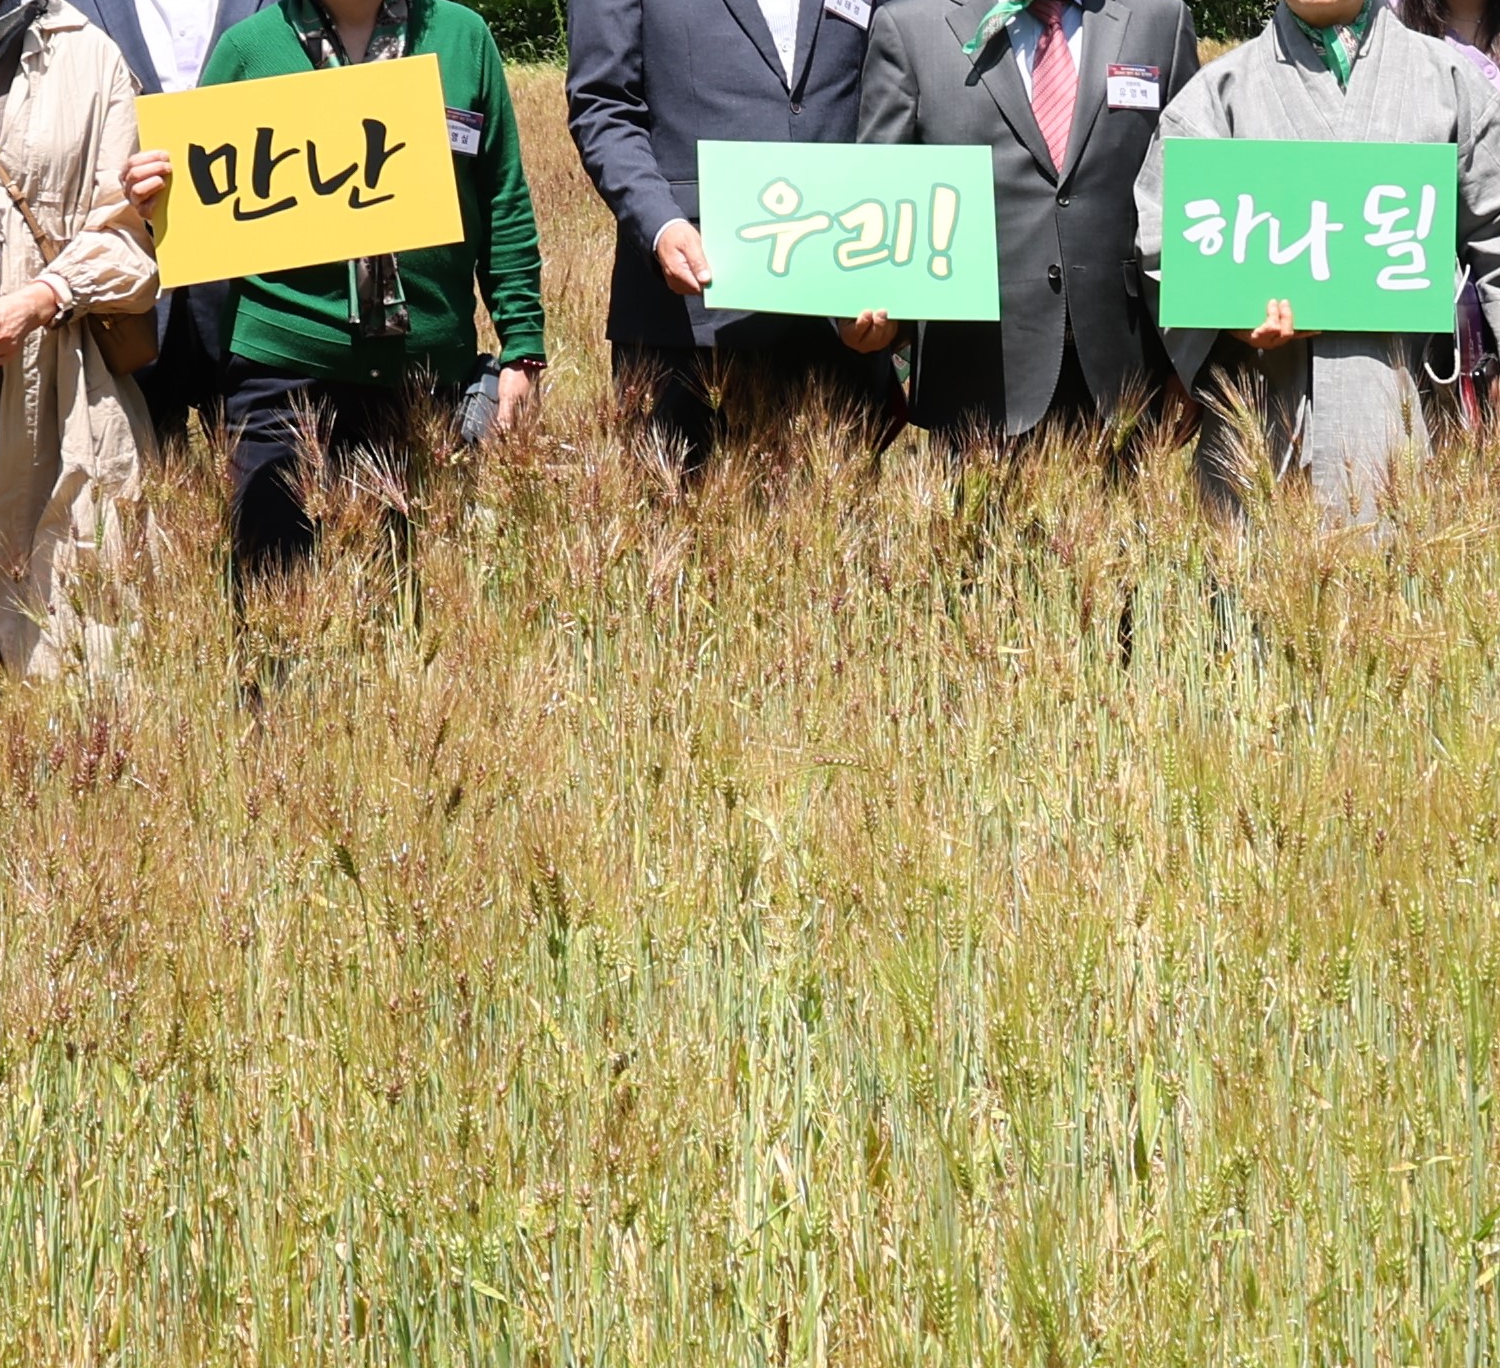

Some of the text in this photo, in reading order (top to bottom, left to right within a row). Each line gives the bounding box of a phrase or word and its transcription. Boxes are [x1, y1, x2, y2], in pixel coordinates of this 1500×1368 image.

[188, 119, 407, 222] 만난
[738, 177, 961, 282] 우리!
[1182, 184, 1436, 291] 하나 될
